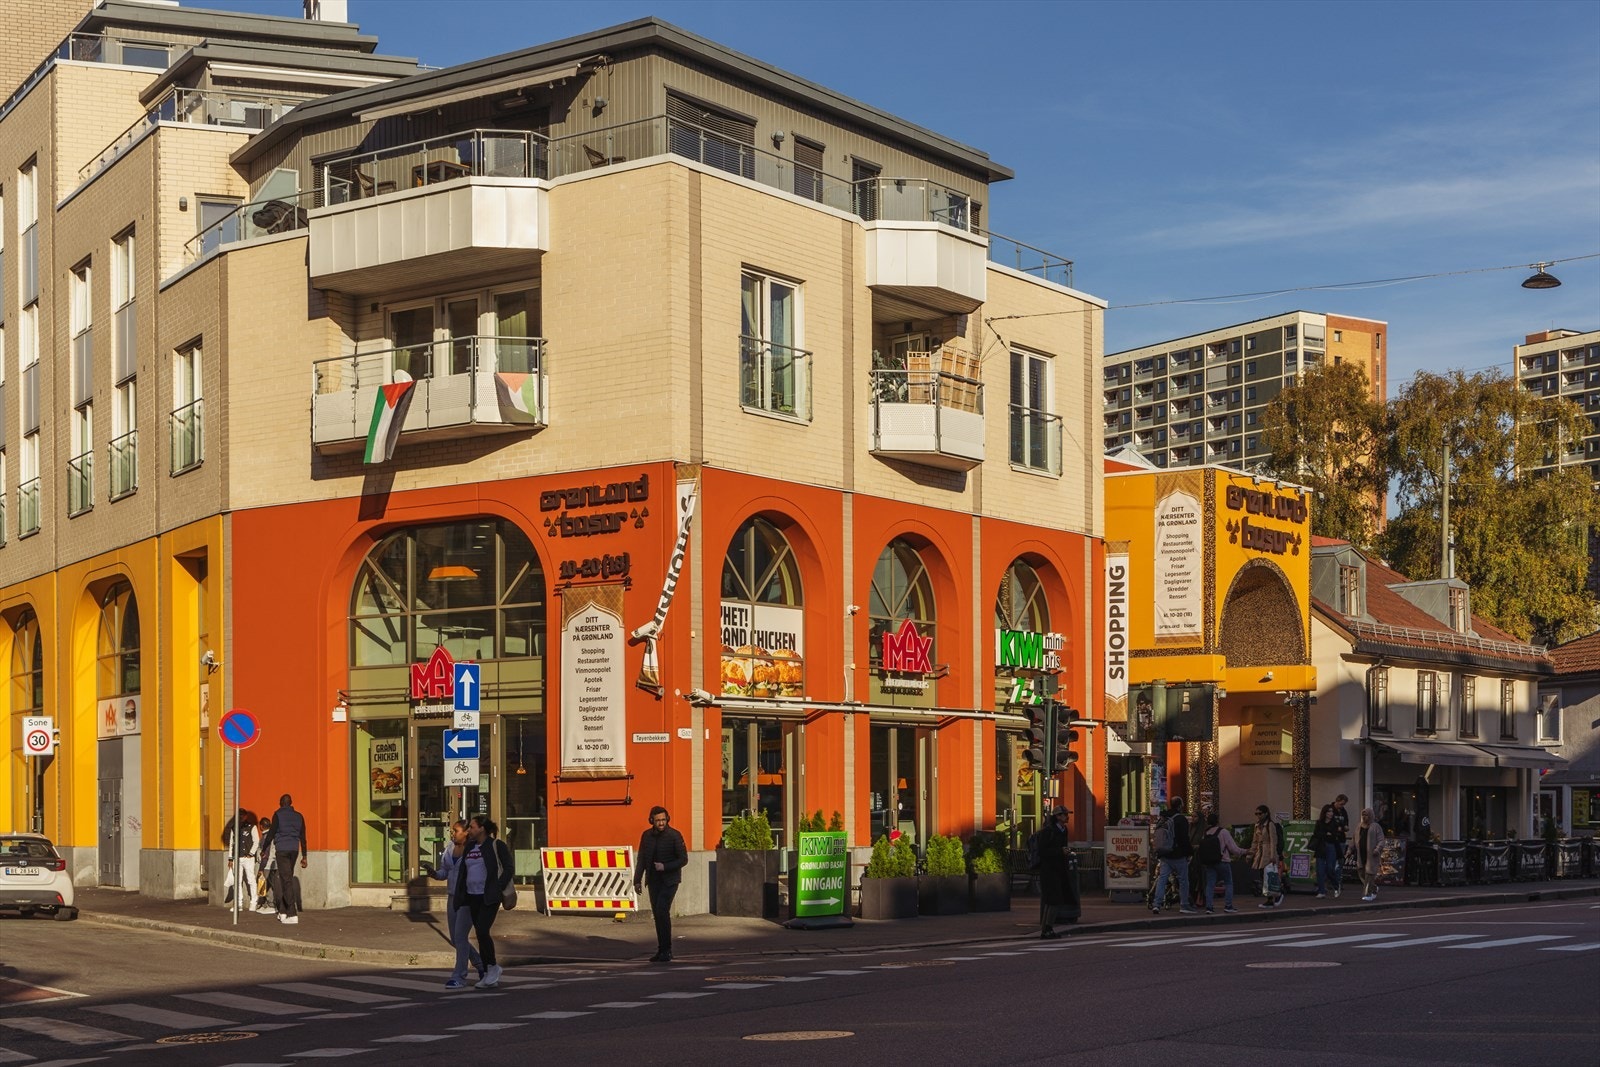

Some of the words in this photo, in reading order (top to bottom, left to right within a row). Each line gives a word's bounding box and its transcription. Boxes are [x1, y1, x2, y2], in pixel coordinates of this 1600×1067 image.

[1158, 519, 1166, 527] PÅ
[1164, 578, 1192, 586] Dagligvarer
[585, 616, 598, 624] DITT
[1108, 565, 1125, 680] SHOPPING
[575, 624, 611, 633] NÆRSENTER
[572, 633, 581, 642] PÅ
[581, 632, 614, 641] GRØNLAND
[720, 626, 747, 647] AND
[750, 629, 796, 651] CHICKEN
[883, 618, 933, 672] MAX
[999, 628, 1043, 669] KIWI
[581, 647, 605, 655] Shopping
[577, 656, 610, 664] Restauranter
[1044, 652, 1061, 670] pris
[411, 646, 455, 699] MA
[575, 666, 611, 674] Vinmonopolet
[584, 676, 603, 684] Apotek
[579, 695, 608, 704] Legesenter
[578, 705, 609, 713] Dagligvarer
[582, 714, 605, 722] Skredder
[31, 735, 46, 746] 30
[636, 734, 667, 742] Tøyenbekken
[600, 743, 610, 751] (18)
[374, 752, 399, 762] CHICKEN
[801, 835, 833, 856] KIWI
[1111, 837, 1142, 845] CRUNCHY
[1286, 837, 1314, 853] 7-2
[801, 862, 829, 870] GRØNLAND
[801, 876, 843, 891] INNGANG
